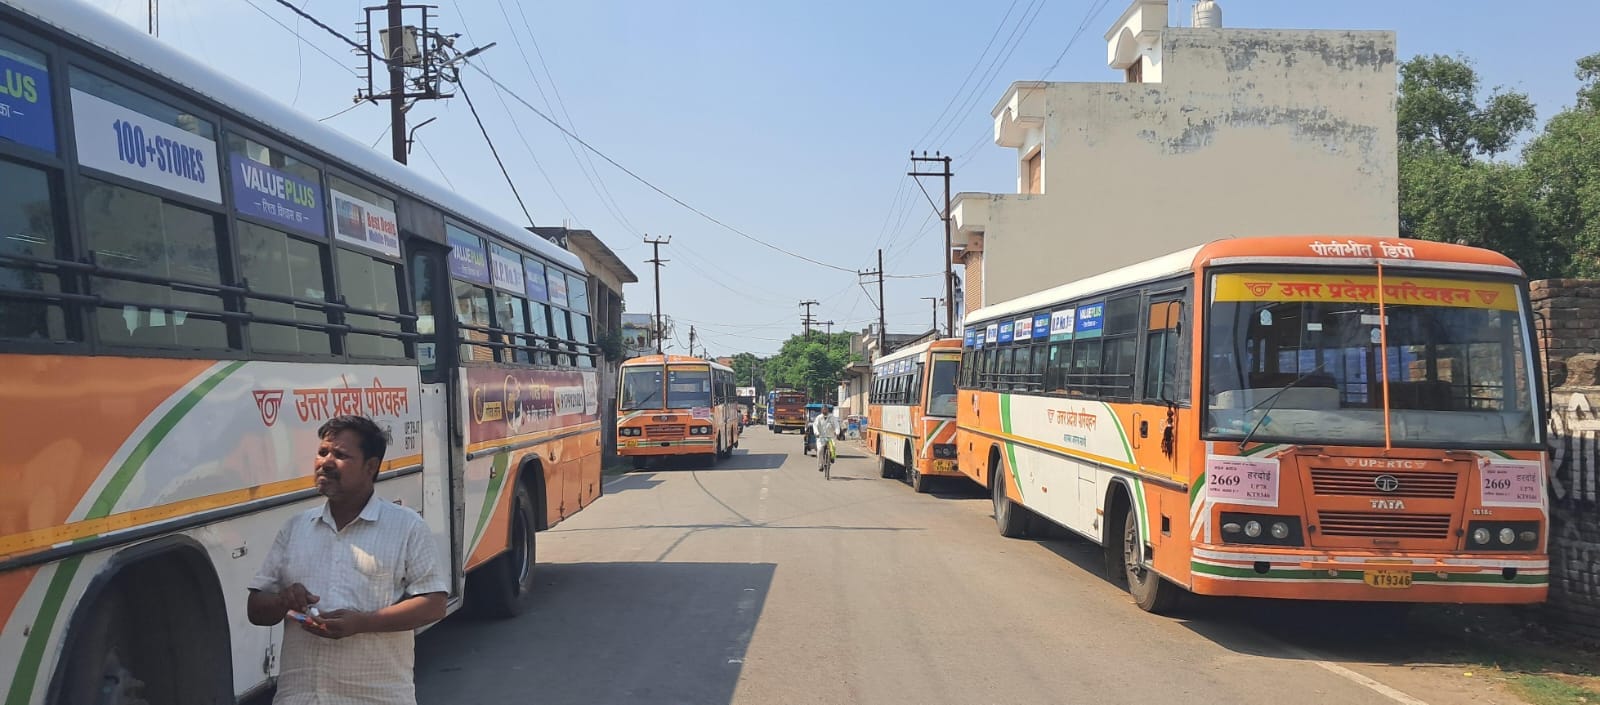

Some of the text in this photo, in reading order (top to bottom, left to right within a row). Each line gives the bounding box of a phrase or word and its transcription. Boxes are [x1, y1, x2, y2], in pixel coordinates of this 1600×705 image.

[113, 118, 206, 184] 100+STORES
[1309, 240, 1372, 257] पीलीभीत
[1278, 279, 1471, 304] उत्तर प्रदेश परिवहन
[293, 374, 409, 422] उत्तर प्रदेश परिवहन
[1210, 474, 1241, 486] 2669
[1247, 470, 1272, 481] हरदोई
[1484, 478, 1511, 490] 2669
[1369, 499, 1406, 510] TATA
[1373, 574, 1410, 586] KT9346
